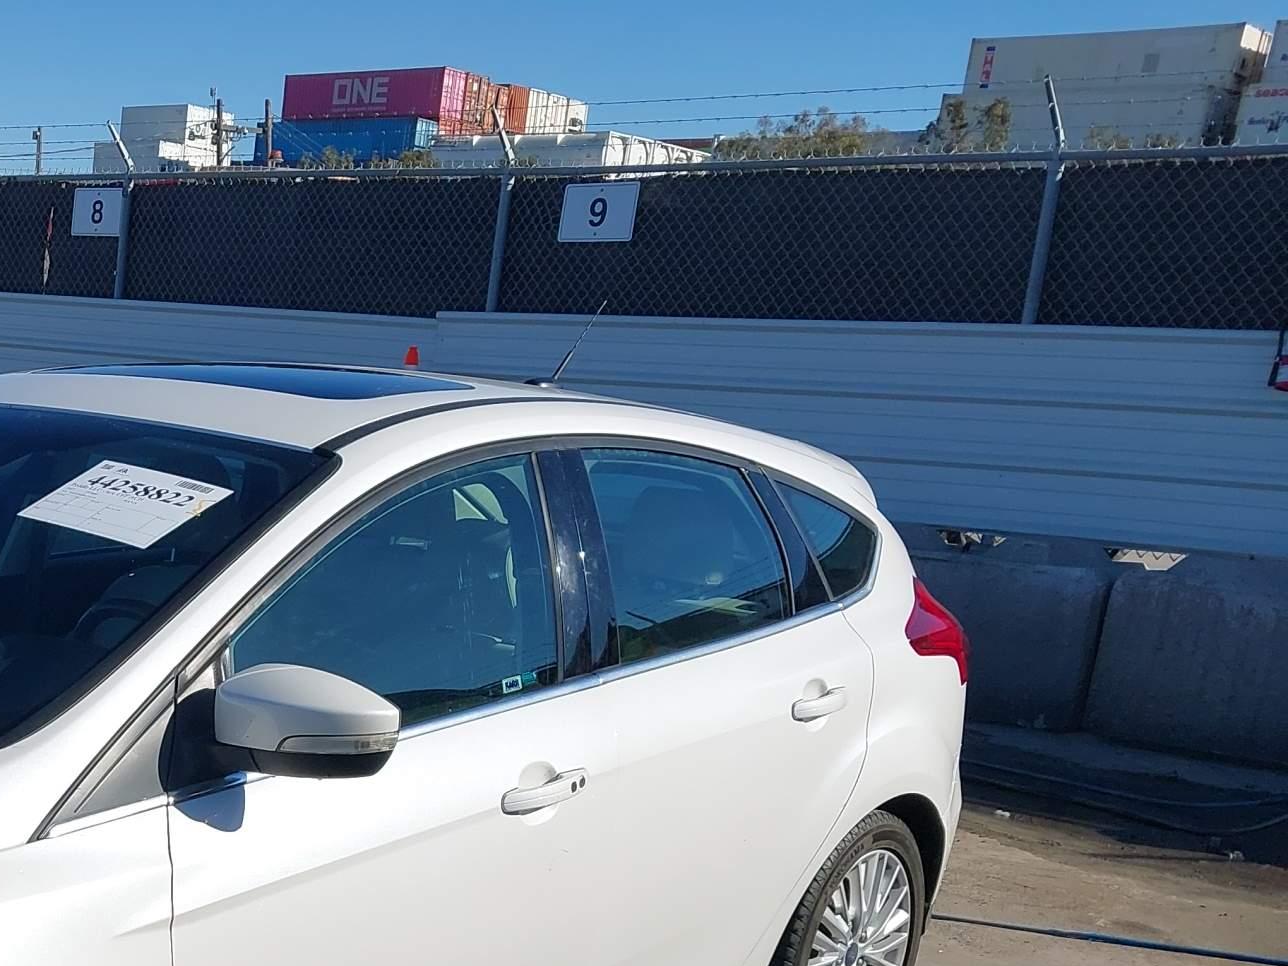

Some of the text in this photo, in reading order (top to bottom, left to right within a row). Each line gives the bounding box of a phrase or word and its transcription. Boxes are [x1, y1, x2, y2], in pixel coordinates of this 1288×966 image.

[332, 76, 390, 105] ONE
[91, 199, 104, 225] 8
[588, 197, 608, 228] 9
[87, 475, 196, 507] 44258822
